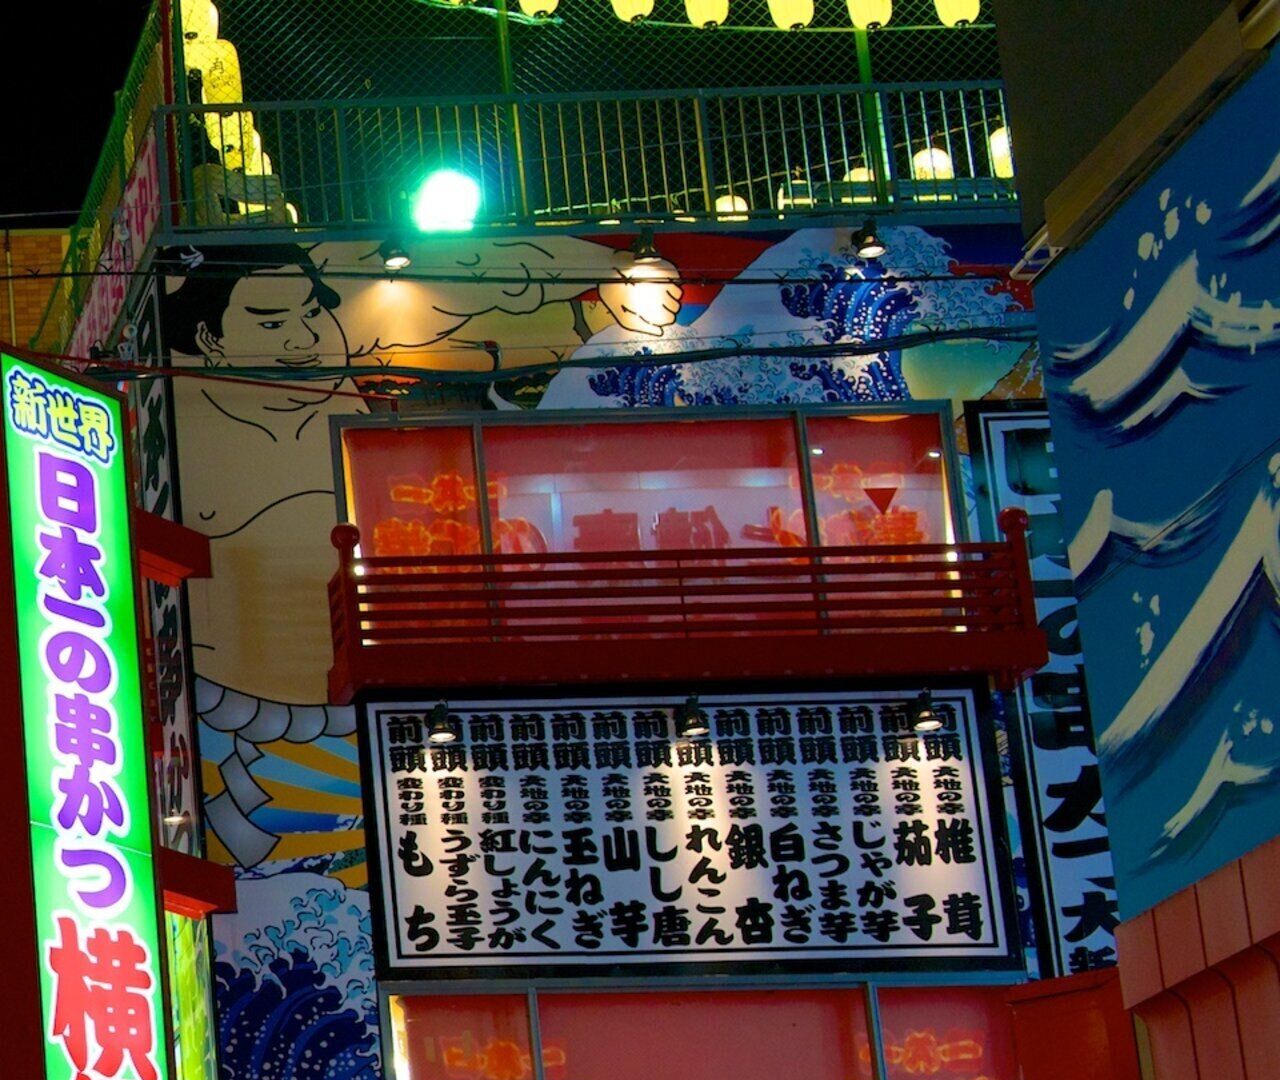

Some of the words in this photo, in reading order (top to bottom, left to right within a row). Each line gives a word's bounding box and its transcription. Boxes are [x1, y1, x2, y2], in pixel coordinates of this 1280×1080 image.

[10, 372, 116, 460] 新世界
[37, 451, 127, 908] 日本一の串かつ
[387, 716, 426, 773] 前頭
[469, 715, 508, 772] 前頭
[509, 713, 550, 770] 前頭
[551, 712, 590, 769] 前頭
[592, 711, 631, 768] 前頭
[634, 710, 671, 768] 前頭
[714, 708, 755, 766] 前頭
[756, 707, 796, 765] 前頭
[797, 706, 837, 764] 前頭
[838, 705, 879, 763] 前頭
[397, 777, 426, 825] 変わり種
[438, 777, 468, 825] 変わり種
[479, 776, 509, 824] 変わり種
[520, 775, 550, 823] 大地の幸
[560, 775, 591, 823] 大地の幸
[602, 774, 632, 823] 大地の幸
[643, 773, 673, 822] 大地の幸
[684, 772, 714, 820] 大地の幸
[726, 771, 756, 819] 大地の幸
[767, 770, 798, 818] 大地の幸
[808, 769, 839, 817] 大地の幸
[849, 768, 881, 816] 大地の幸
[891, 767, 922, 815] 大地の幸
[933, 766, 964, 815] 大地の幸
[398, 831, 440, 951] もち
[440, 829, 485, 950] うずら玉子
[478, 829, 526, 948] 紅しょうが
[519, 830, 564, 949] にんにく
[562, 828, 608, 948] 玉ねぎ
[603, 827, 648, 948] 山芋
[645, 826, 691, 947] しし唐
[686, 825, 734, 945] れんこん
[725, 824, 774, 945] 銀杏
[770, 823, 816, 943] 白ねぎ
[811, 822, 858, 943] さつま芋
[894, 820, 942, 940] 茄子
[935, 818, 984, 940] 椎茸
